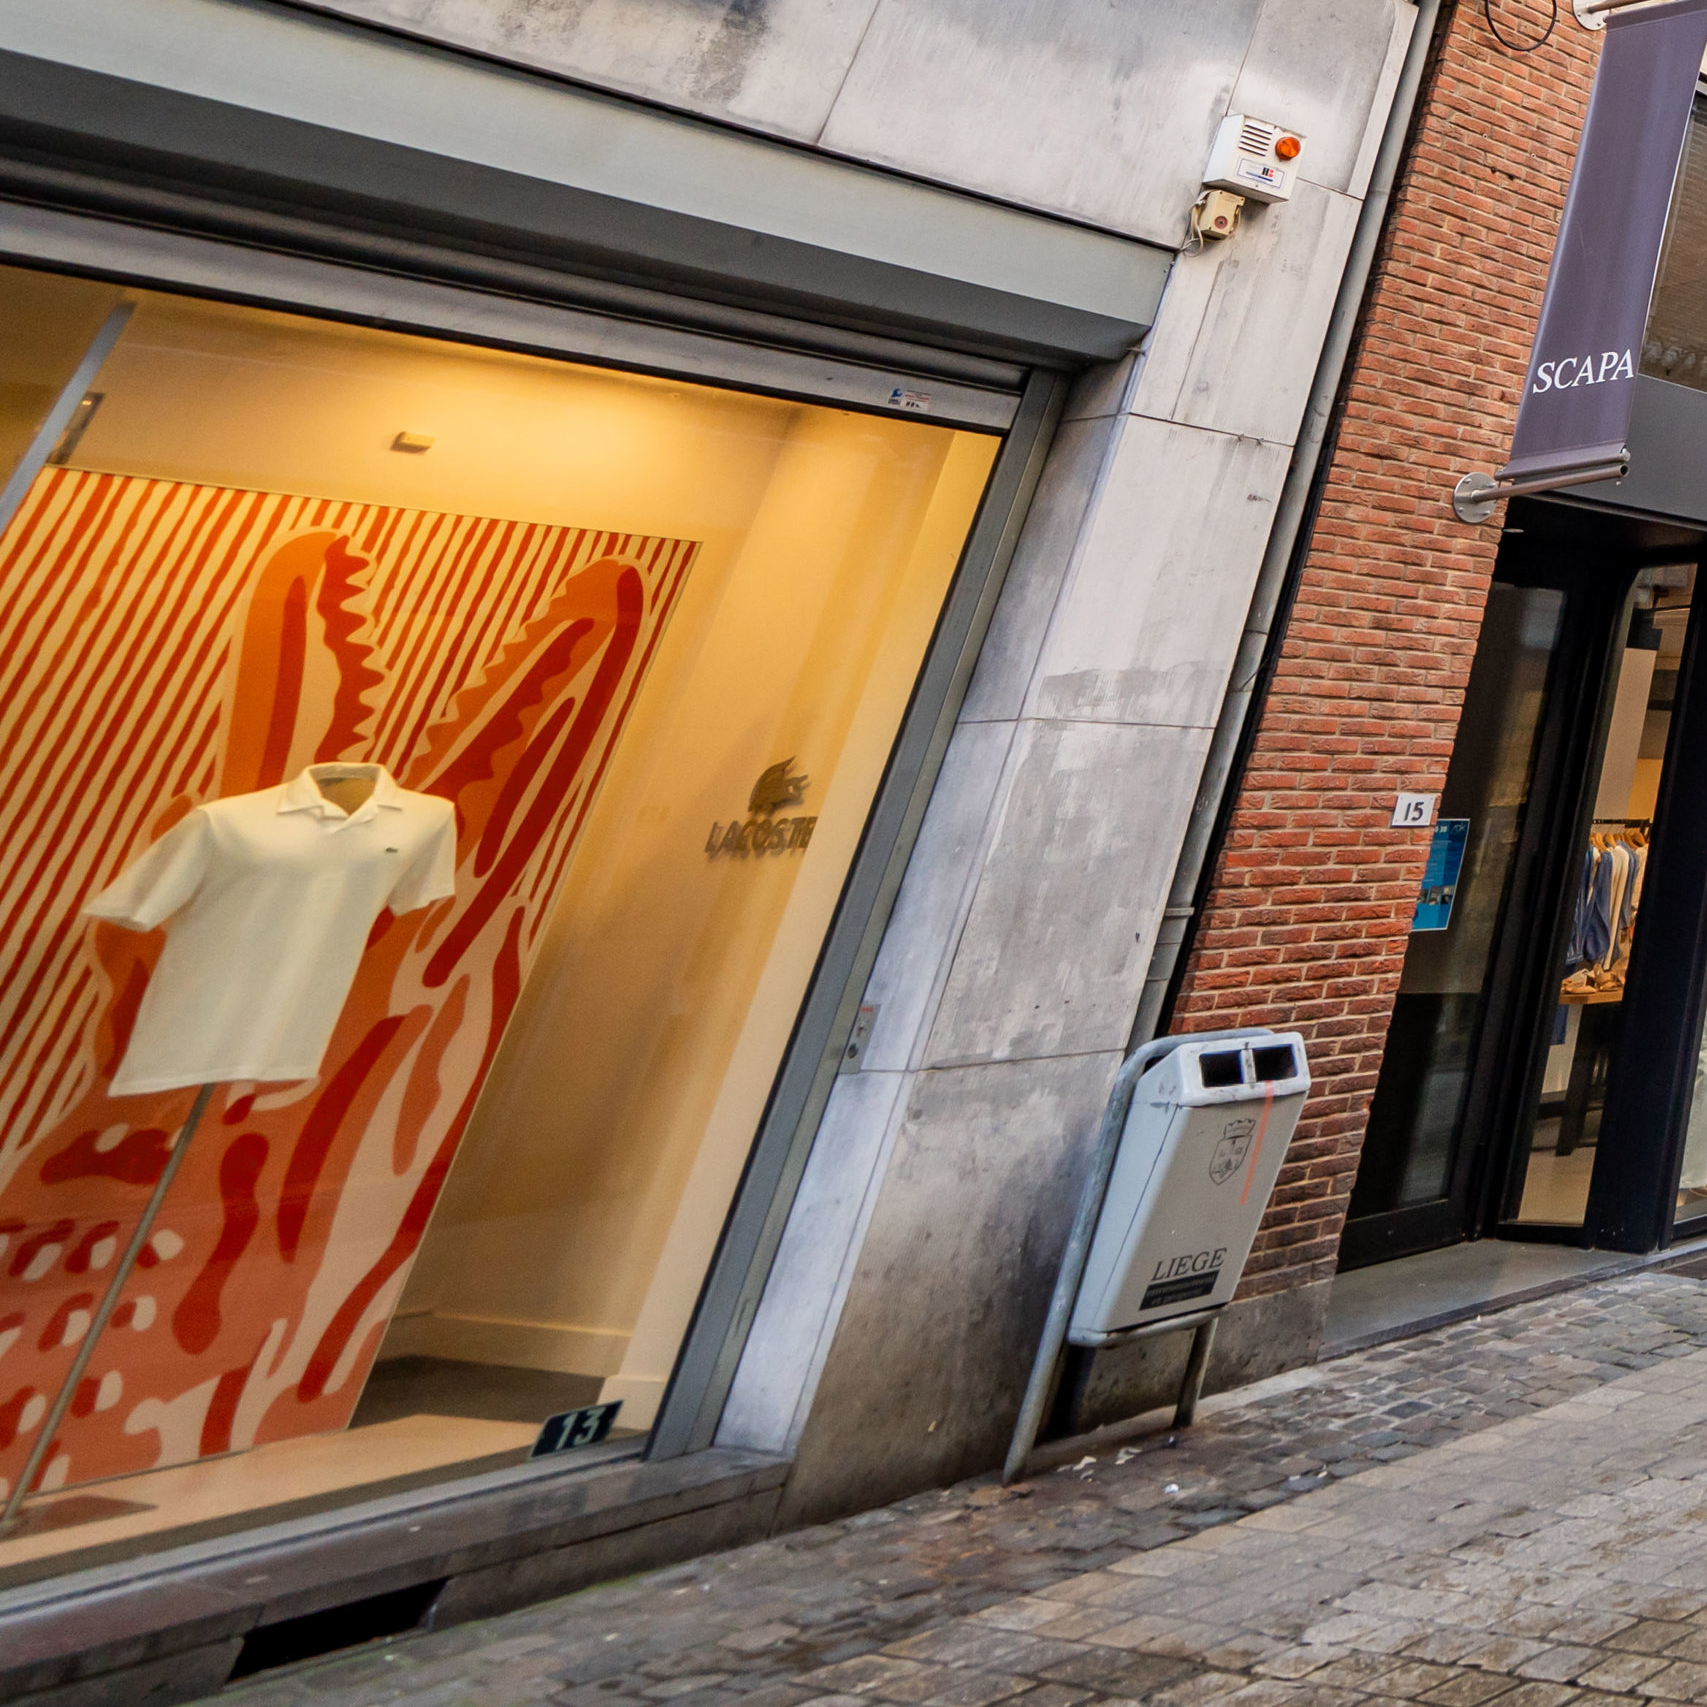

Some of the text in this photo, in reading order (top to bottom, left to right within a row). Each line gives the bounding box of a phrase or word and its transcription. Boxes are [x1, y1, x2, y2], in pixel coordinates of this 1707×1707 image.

[1532, 348, 1635, 394] SCAPA
[1404, 801, 1425, 822] 15
[1151, 1247, 1228, 1282] LIEGE
[555, 1406, 607, 1451] 13
